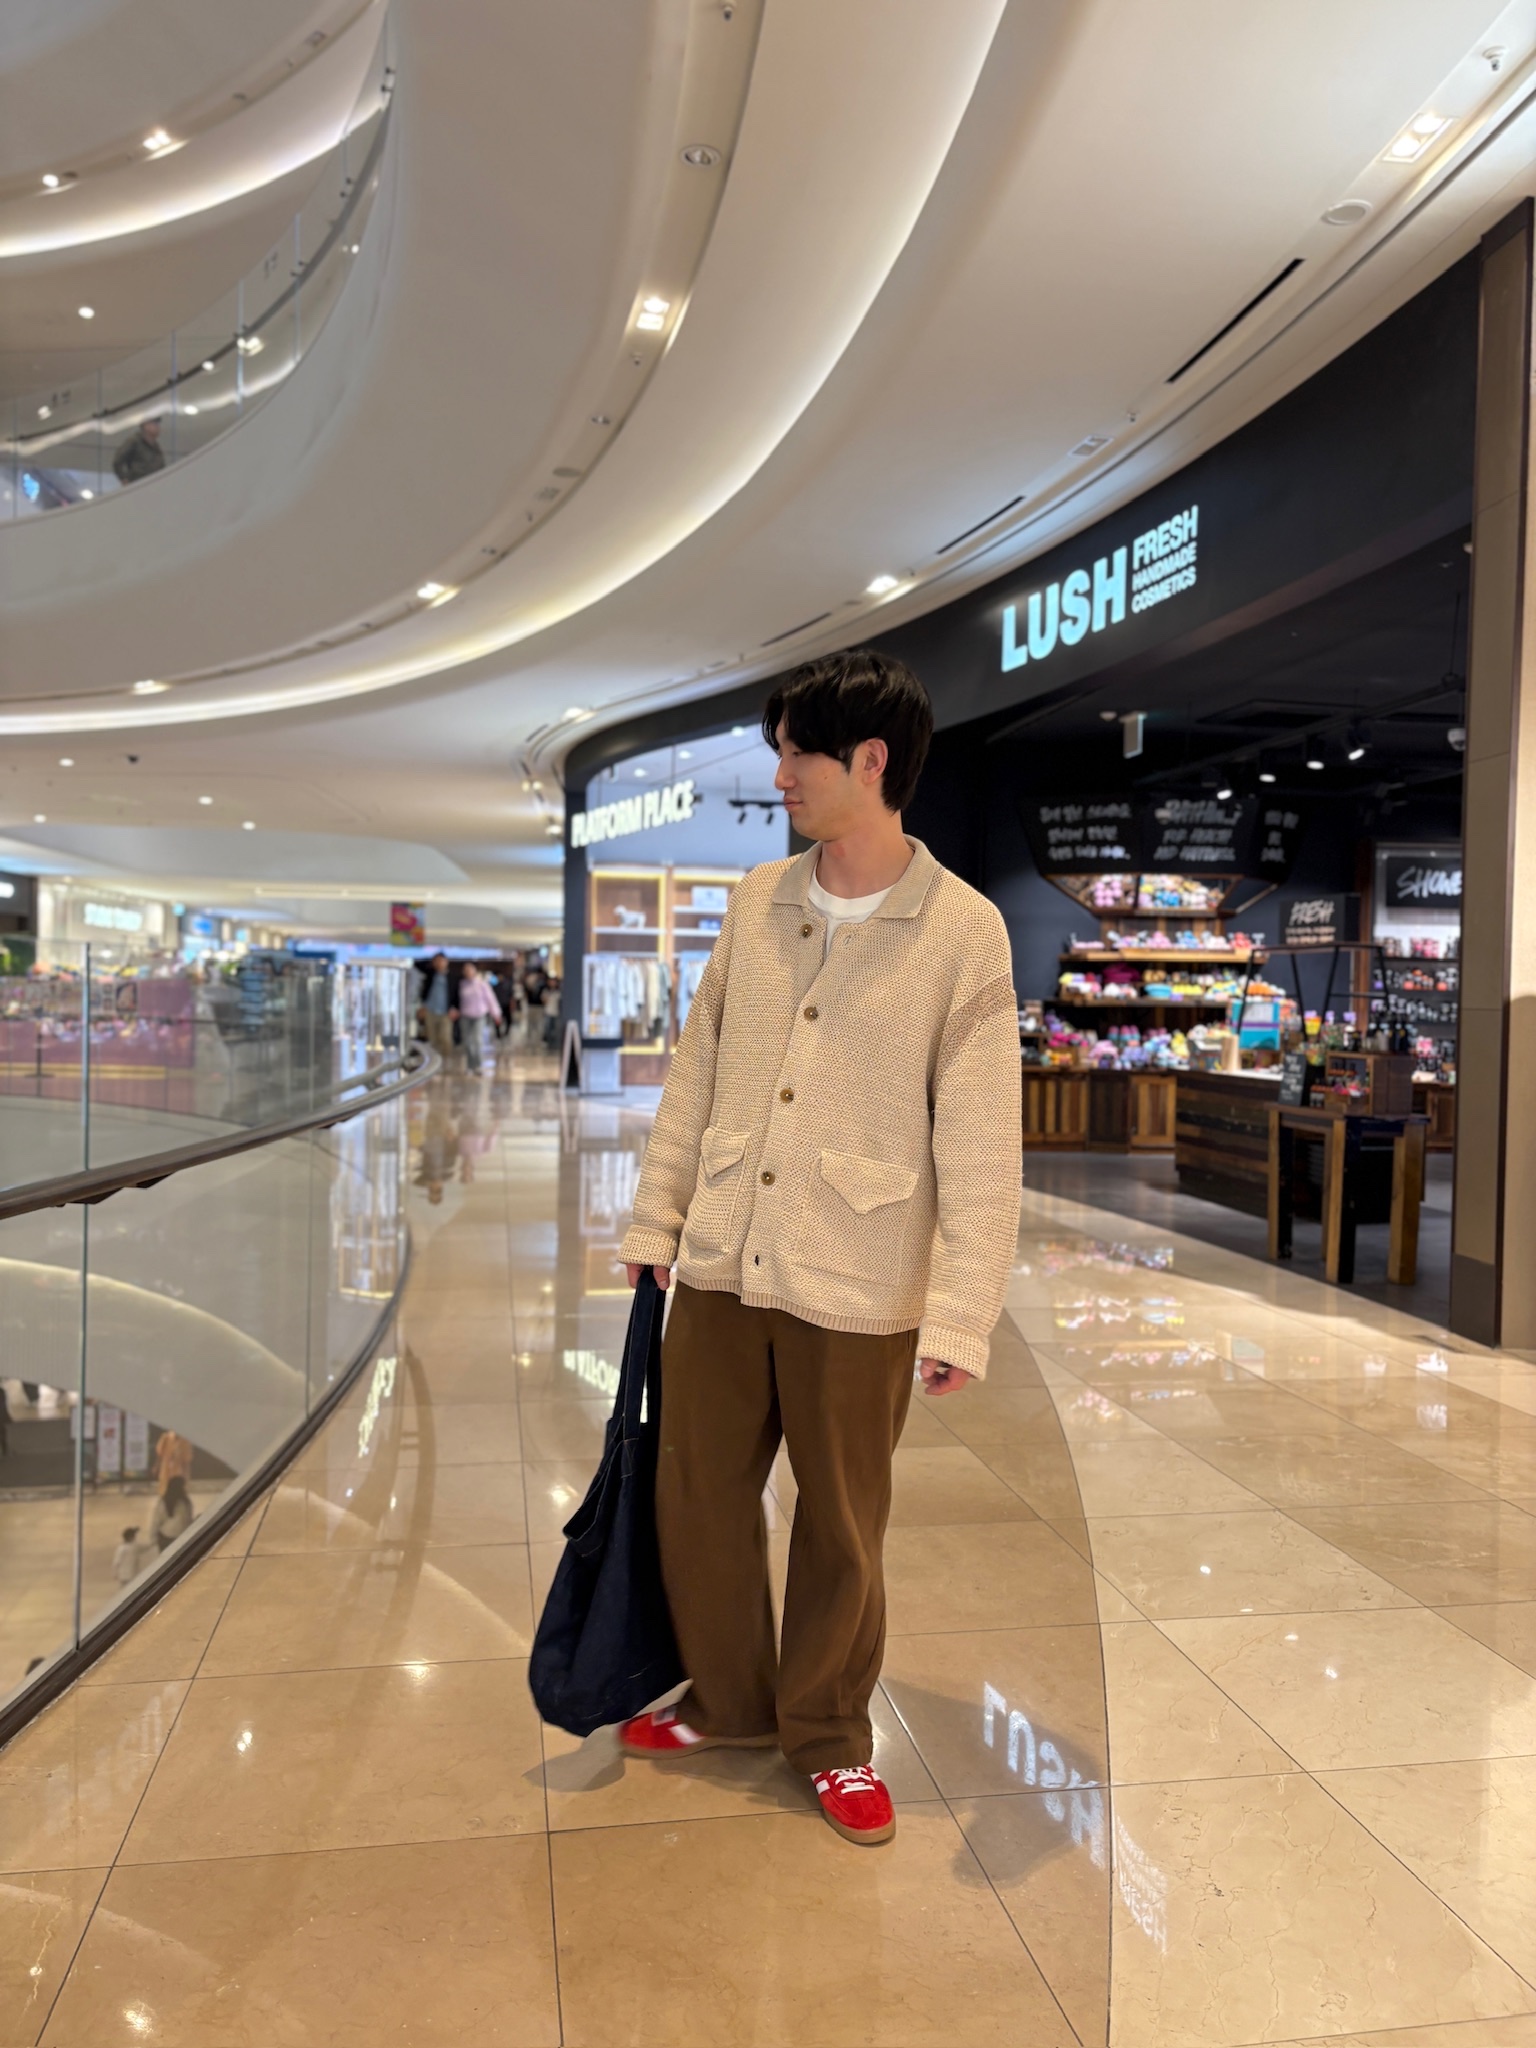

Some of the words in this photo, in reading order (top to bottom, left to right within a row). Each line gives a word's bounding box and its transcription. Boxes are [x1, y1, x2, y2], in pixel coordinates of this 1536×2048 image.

[1131, 541, 1198, 592] HANDMADE
[1132, 504, 1199, 571] FRESH
[1001, 545, 1128, 673] LUSH
[1131, 565, 1197, 614] COSMETICS
[571, 795, 642, 848] PLATFORM
[643, 779, 695, 830] PLACE
[1395, 865, 1463, 899] SHOWE
